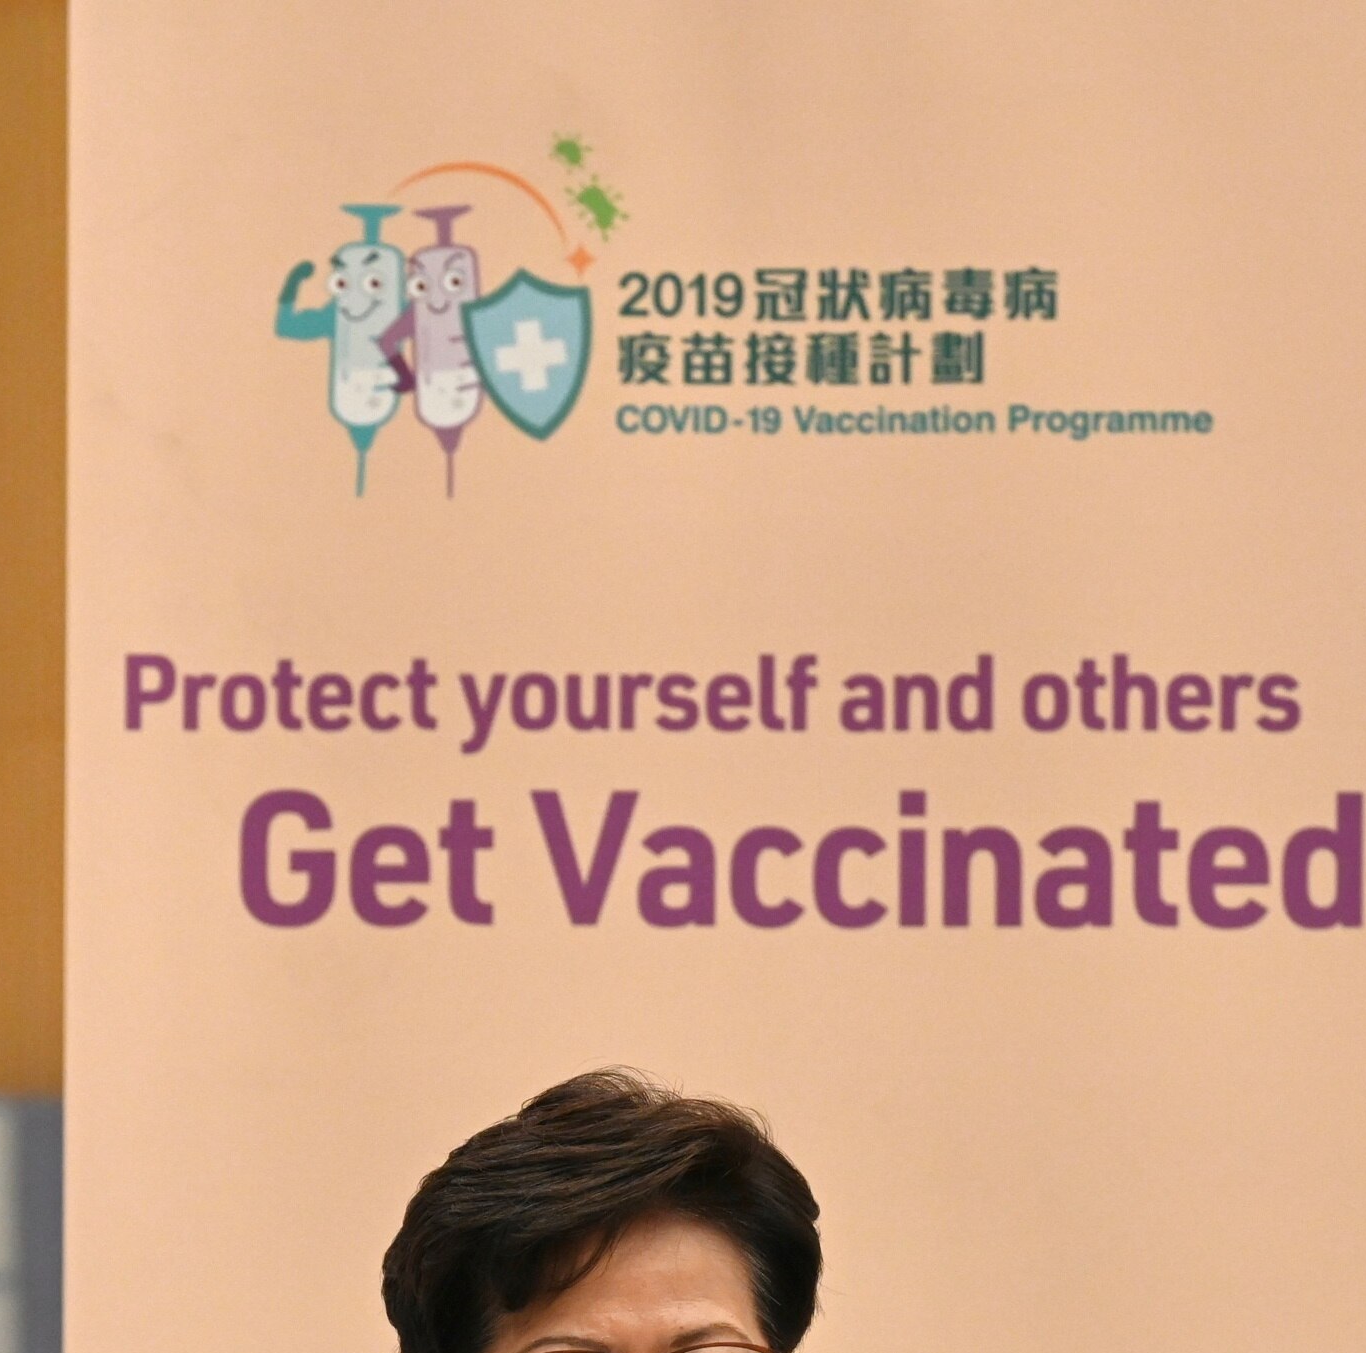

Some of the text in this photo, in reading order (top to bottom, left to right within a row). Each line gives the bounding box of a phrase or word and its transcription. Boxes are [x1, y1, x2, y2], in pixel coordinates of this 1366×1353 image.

[617, 331, 985, 385] 疫苗接種計劃
[615, 404, 1214, 440] COVID-19 Vaccination Programme
[124, 652, 1303, 755] Protect yourself and others
[239, 788, 1365, 931] Get Vaccinated
